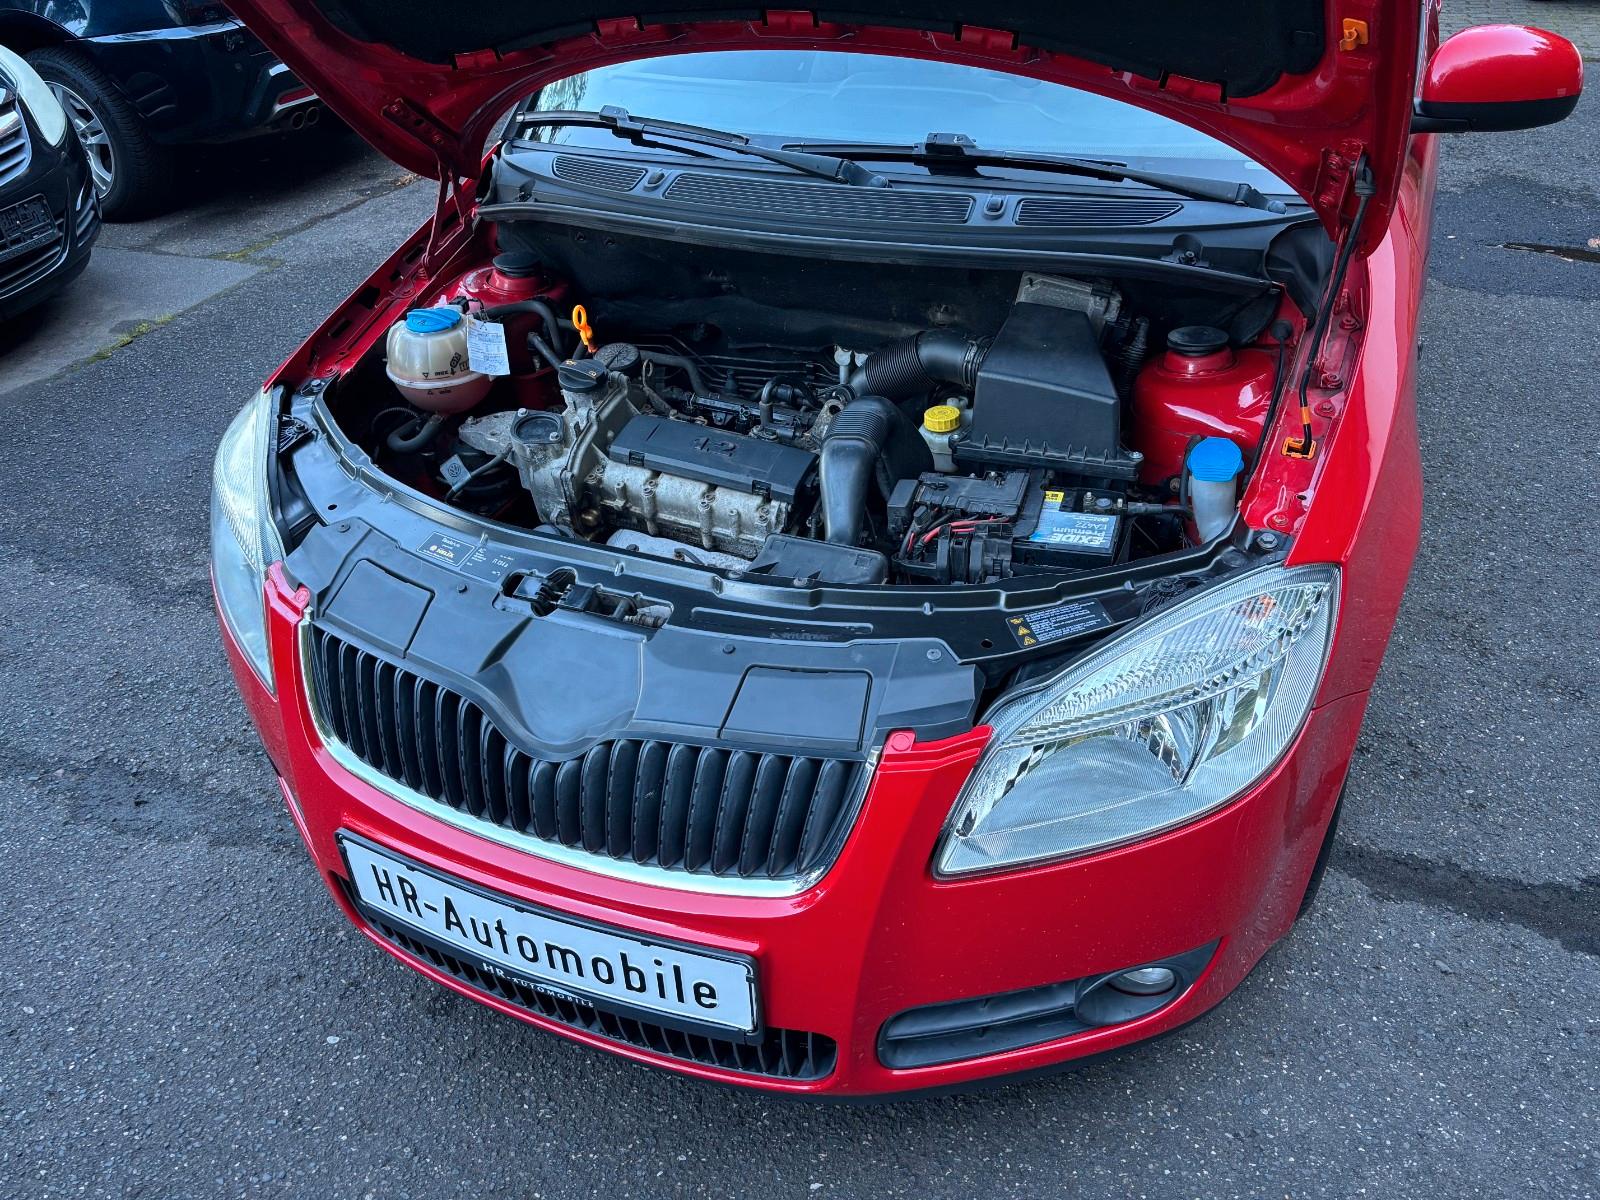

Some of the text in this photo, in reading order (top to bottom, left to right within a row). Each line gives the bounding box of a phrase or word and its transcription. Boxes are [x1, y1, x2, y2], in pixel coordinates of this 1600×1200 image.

[694, 437, 737, 456] 1.2
[1051, 533, 1106, 545] EXIDE
[1052, 526, 1105, 538] Premium
[370, 863, 718, 1009] HR-Automobile
[482, 962, 595, 1008] HR-AUTOMOBILE
